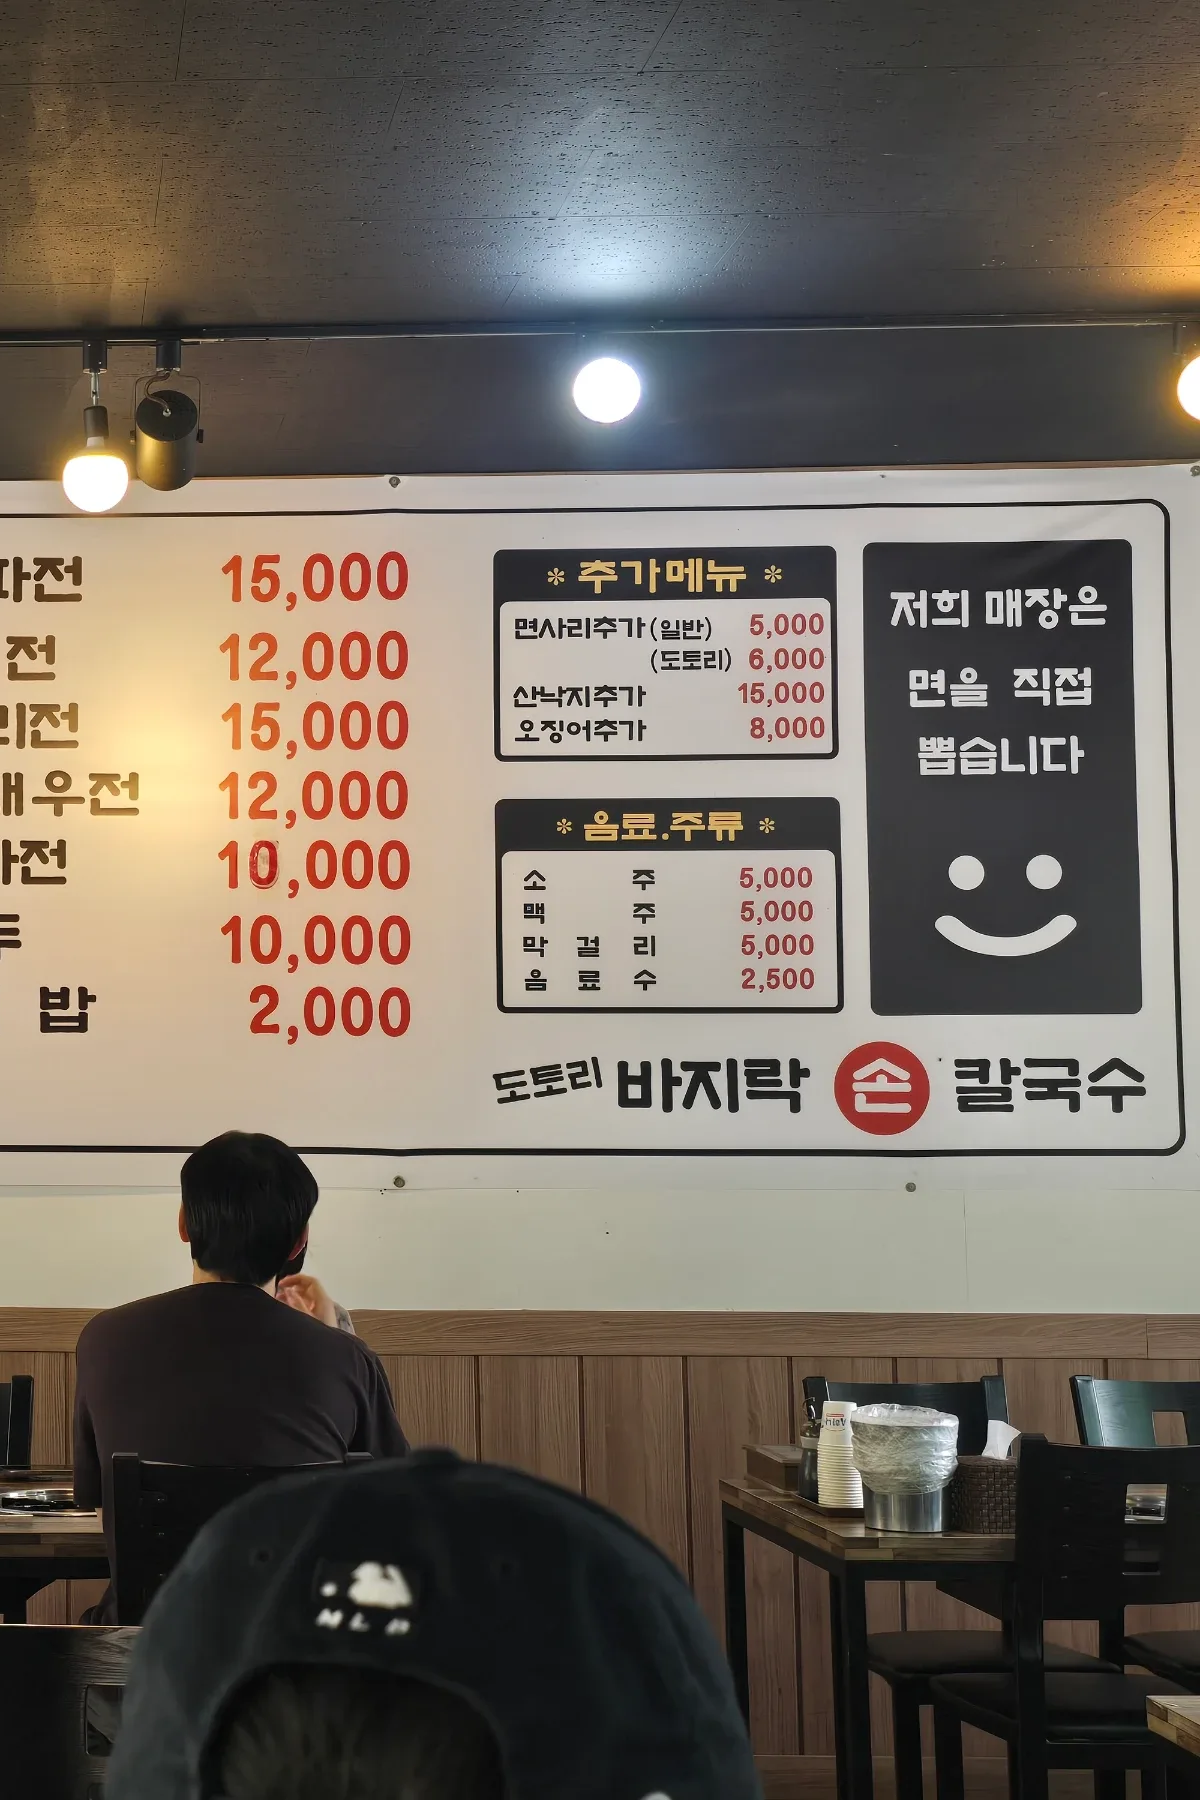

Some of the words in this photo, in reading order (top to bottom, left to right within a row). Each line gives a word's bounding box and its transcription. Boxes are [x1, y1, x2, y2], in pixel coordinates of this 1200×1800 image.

[222, 551, 408, 611] 15,000
[578, 558, 746, 593] 추가메뉴
[891, 590, 969, 628] 저희
[986, 586, 1107, 629] 매장은
[750, 613, 824, 639] 5,000
[220, 631, 408, 690] 12,000
[651, 648, 731, 673] (도토리)
[749, 648, 824, 673] 6,000
[513, 685, 646, 707] 산낙지추가
[738, 682, 824, 707] 15,000
[909, 667, 988, 707] 면을
[1014, 667, 1091, 706] 직접
[222, 701, 408, 759] 15,000
[515, 719, 646, 743] 오징어추가
[750, 717, 824, 742] 8,000
[918, 736, 1084, 775] 뽑습니다
[219, 771, 408, 829] 12,000
[218, 840, 410, 898] 10,000
[740, 867, 812, 892] 5,000
[741, 900, 813, 925] 5,000
[221, 915, 410, 973] 10,000
[742, 934, 814, 959] 5,000
[742, 968, 814, 993] 2,500
[250, 985, 410, 1045] 2,000
[493, 1057, 602, 1104] 도토리
[618, 1058, 810, 1113] 바지락
[850, 1055, 914, 1114] 손
[954, 1058, 1146, 1113] 칼국수
